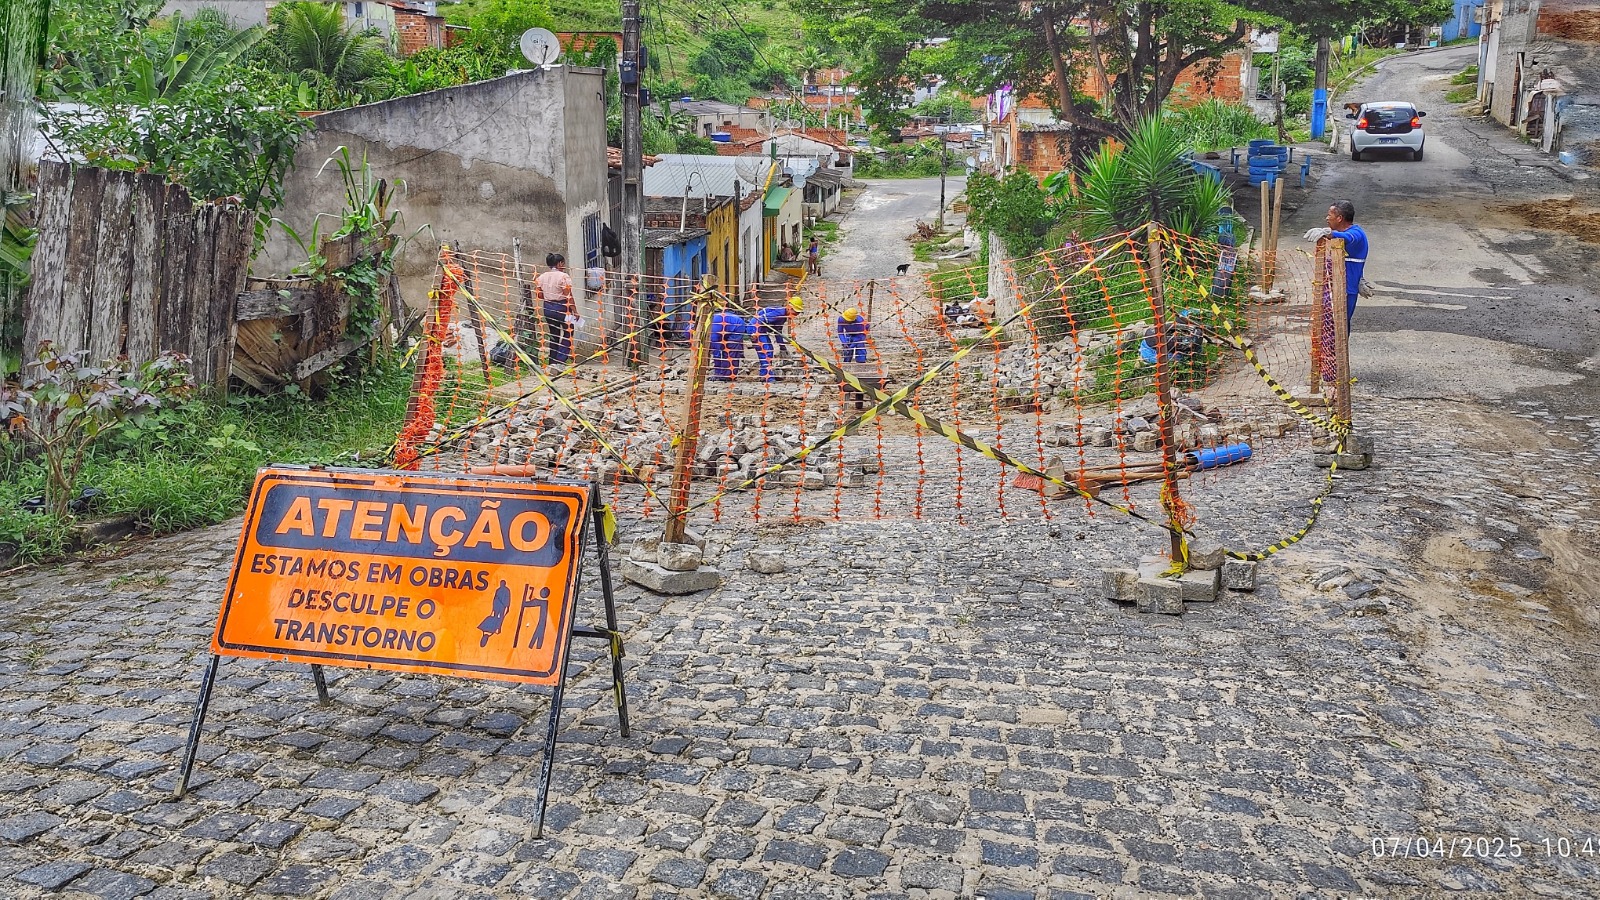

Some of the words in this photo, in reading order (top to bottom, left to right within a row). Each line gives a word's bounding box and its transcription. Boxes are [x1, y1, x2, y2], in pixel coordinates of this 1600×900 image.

[274, 497, 551, 556] ATENÇÃO
[250, 554, 360, 581] ESTAMOS
[368, 562, 402, 585] EM
[409, 565, 489, 592] OBRAS
[287, 588, 409, 618] DESCULPE
[416, 599, 436, 620] O
[274, 618, 436, 652] TRANSTORNO
